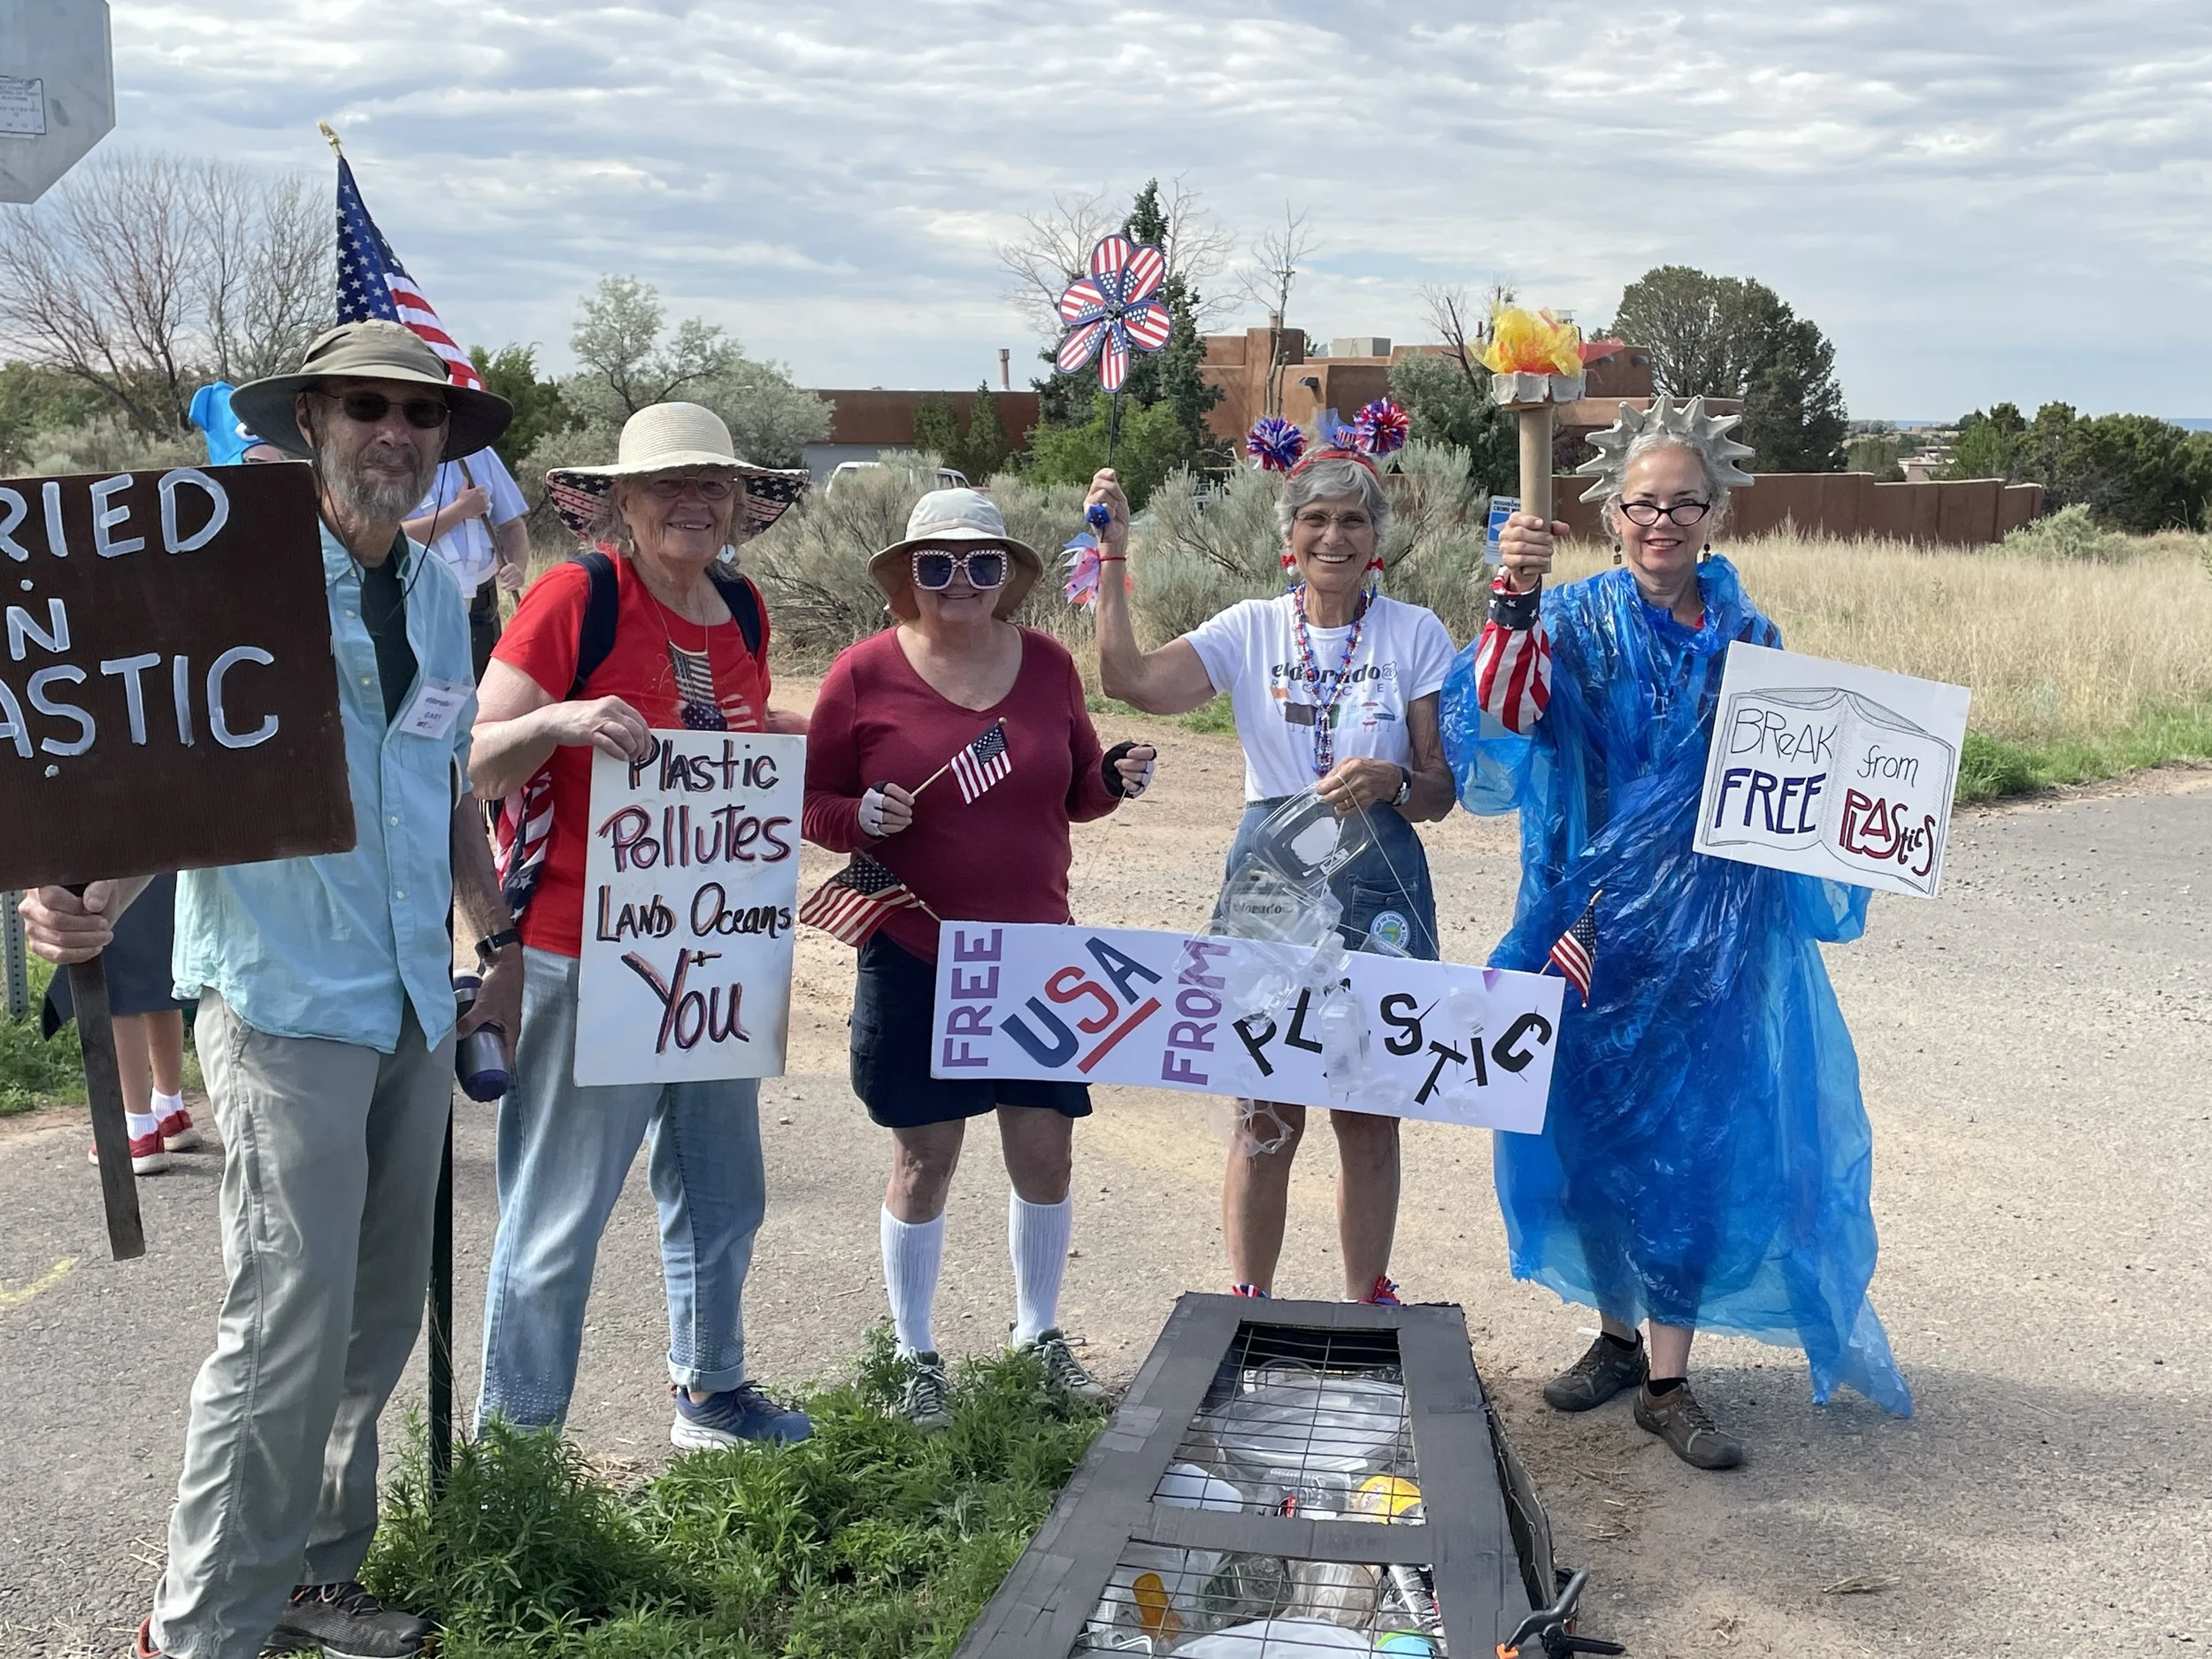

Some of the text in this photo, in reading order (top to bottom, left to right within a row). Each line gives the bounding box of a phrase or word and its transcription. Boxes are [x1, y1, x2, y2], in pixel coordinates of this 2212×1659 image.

[1856, 745, 1919, 787] from
[1715, 768, 1826, 833] FREE
[689, 882, 793, 939] Oceans
[942, 929, 1552, 1105] FREE USA FROM PLSTIC
